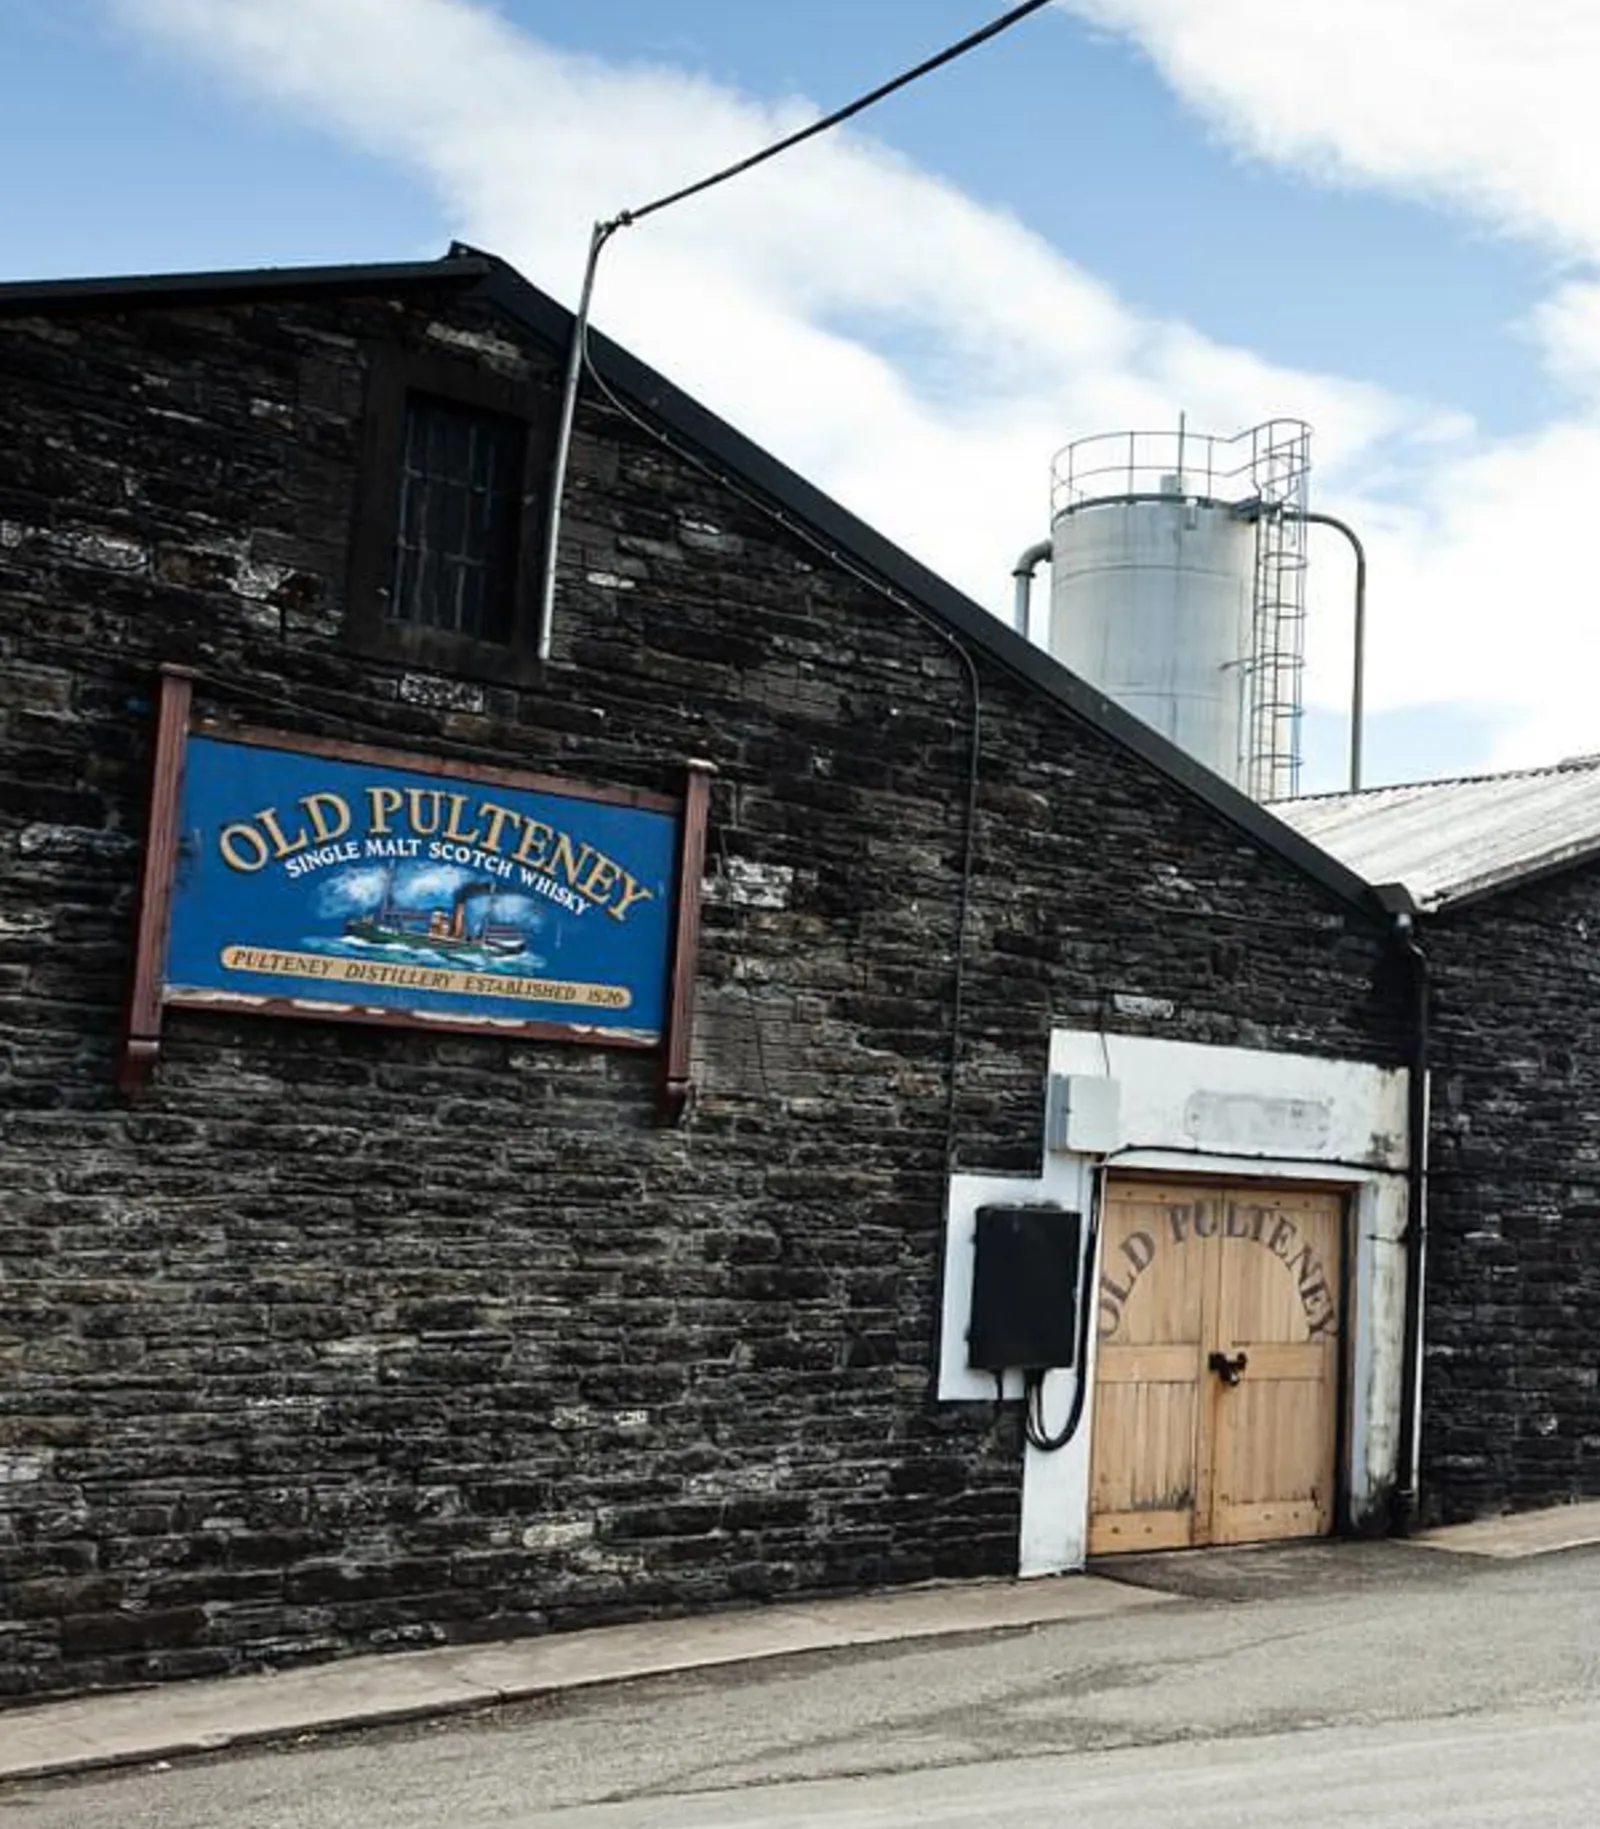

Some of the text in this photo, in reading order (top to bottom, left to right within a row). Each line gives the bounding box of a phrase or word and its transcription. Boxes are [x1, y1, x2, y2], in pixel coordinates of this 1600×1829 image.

[219, 786, 653, 921] OLD PULTENEY
[284, 839, 592, 915] SINGLE MALT SCOTCH WHISKY
[231, 950, 334, 976] PULTENEY
[345, 962, 456, 989] DISTILLERY
[464, 975, 577, 1001] ESTABLISHED
[1099, 1200, 1339, 1342] OLD PULTENEY
